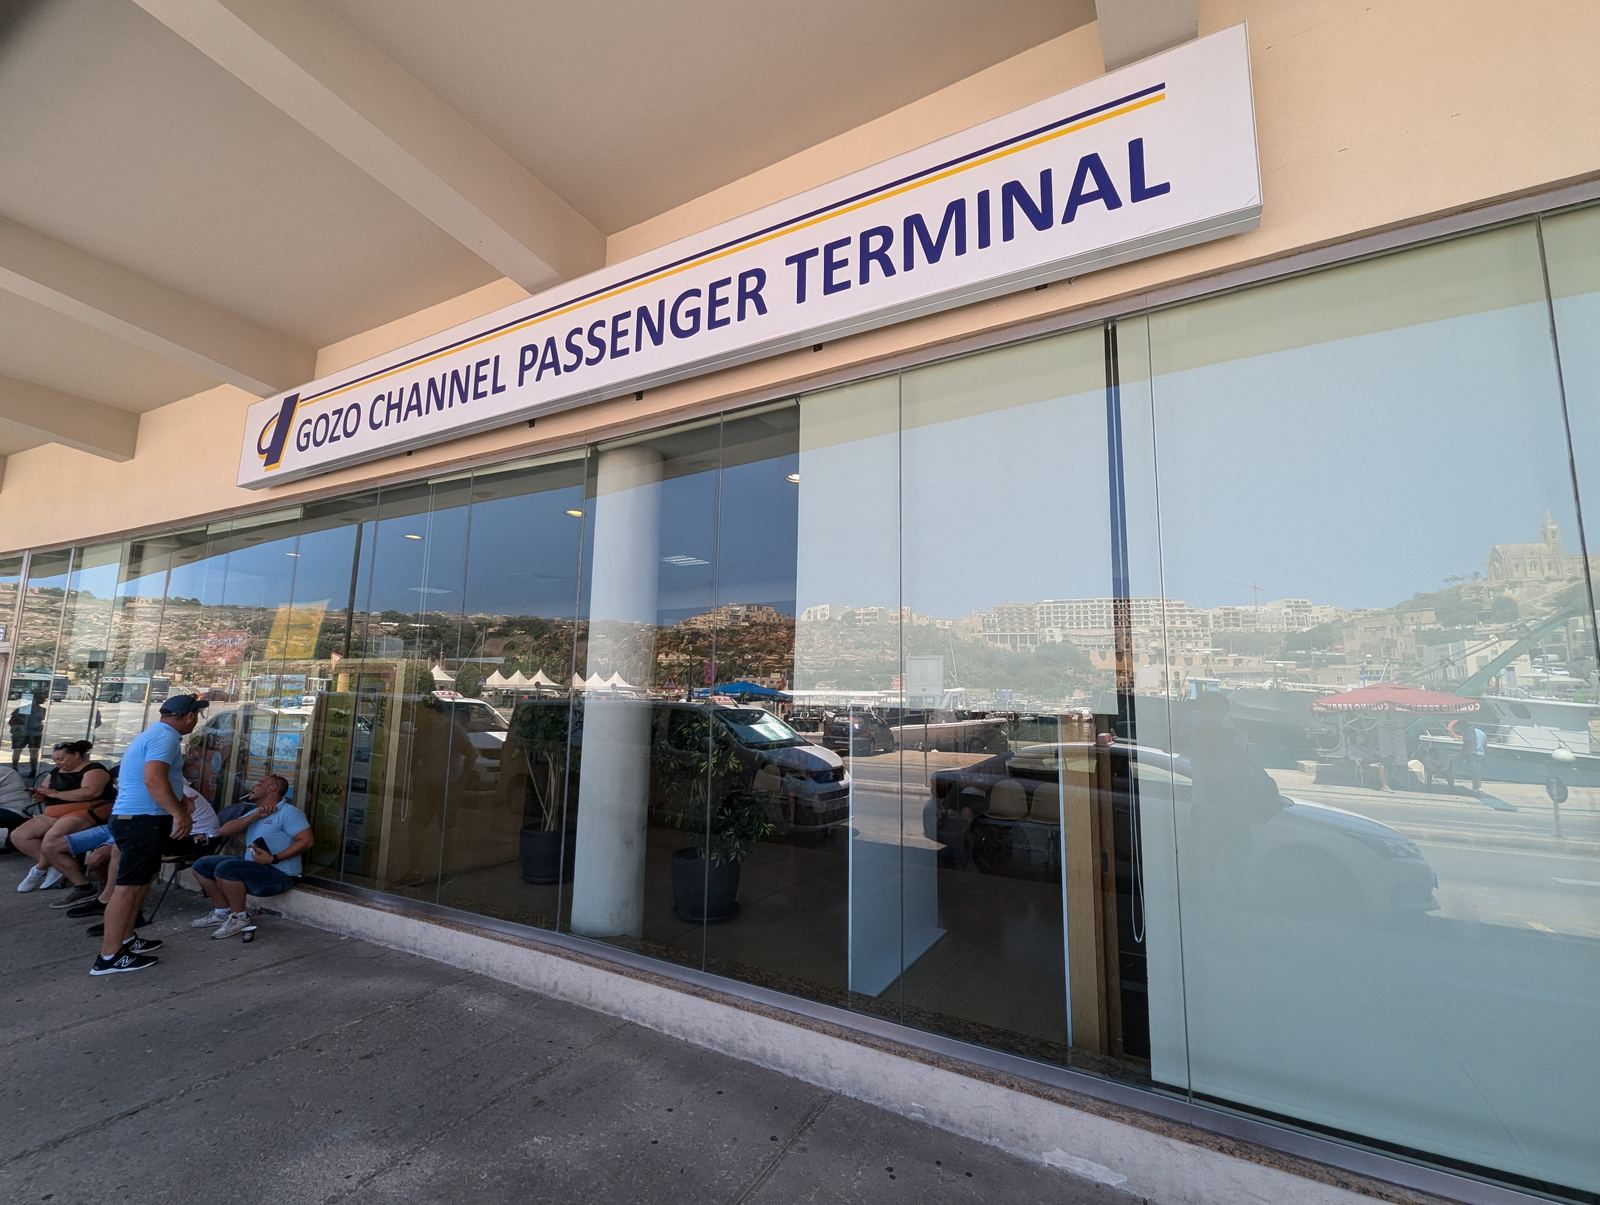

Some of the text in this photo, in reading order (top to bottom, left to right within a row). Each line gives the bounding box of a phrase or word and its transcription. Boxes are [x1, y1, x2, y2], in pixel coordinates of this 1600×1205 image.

[296, 137, 1171, 453] GOZO CHANNEL PASSENGER TERMINAL
